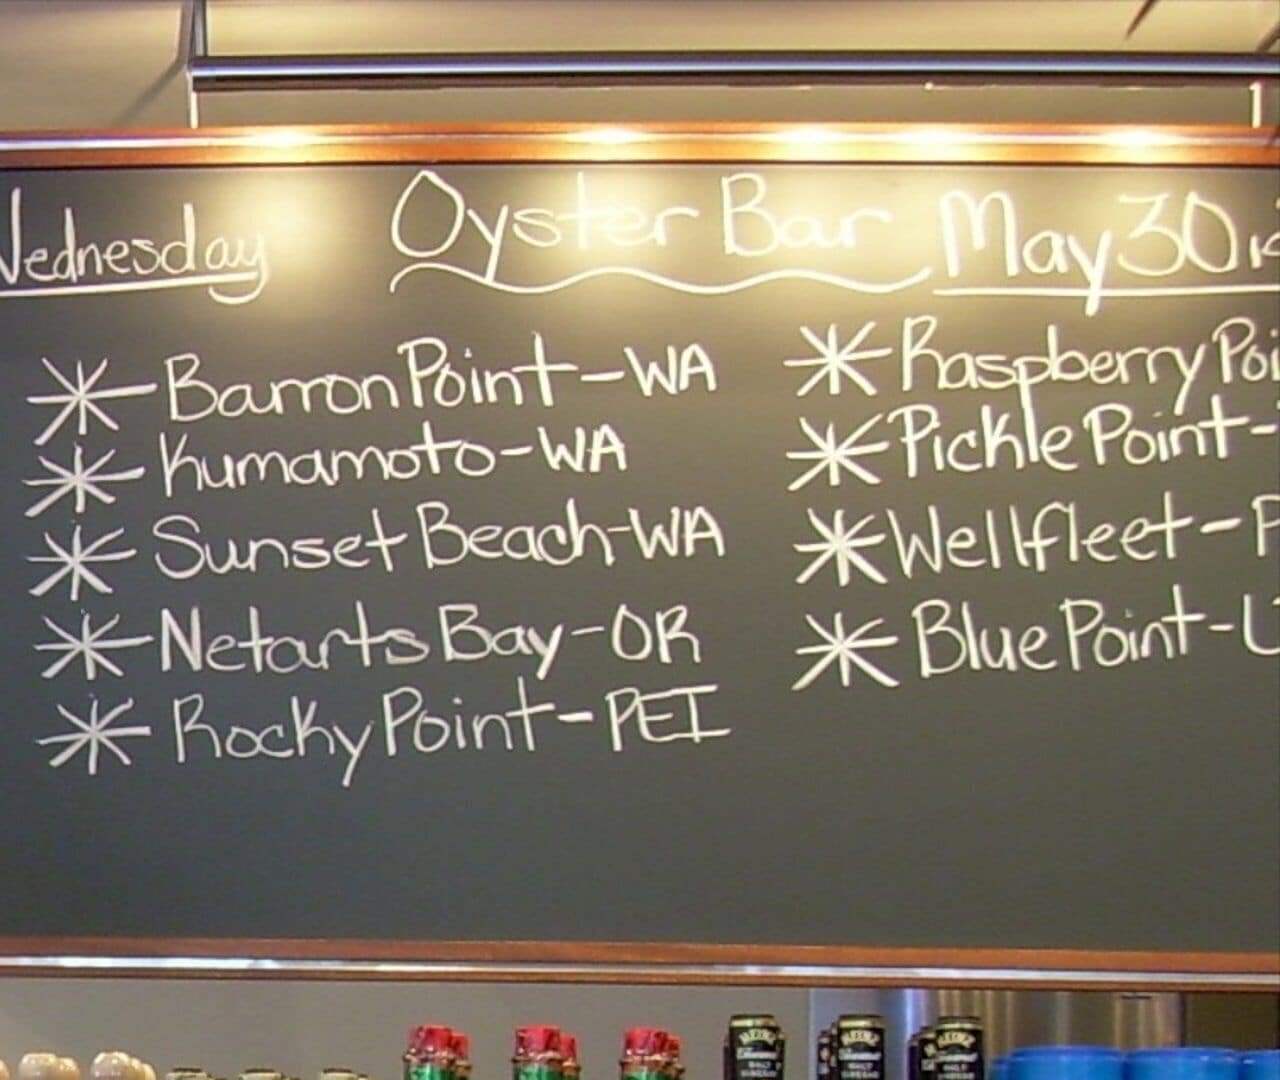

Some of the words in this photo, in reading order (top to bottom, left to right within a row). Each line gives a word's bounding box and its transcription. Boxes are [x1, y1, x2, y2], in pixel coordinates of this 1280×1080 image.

[390, 170, 700, 284] Oyster
[720, 173, 894, 257] Bar
[942, 191, 1113, 317] May
[900, 315, 1205, 463] Raspberry
[1212, 317, 1280, 386] Poi
[886, 402, 1081, 480] Pickle
[152, 508, 409, 582] Sunset
[159, 600, 430, 676] Netarts
[910, 598, 1058, 679] Blue
[172, 692, 376, 788] Rocky
